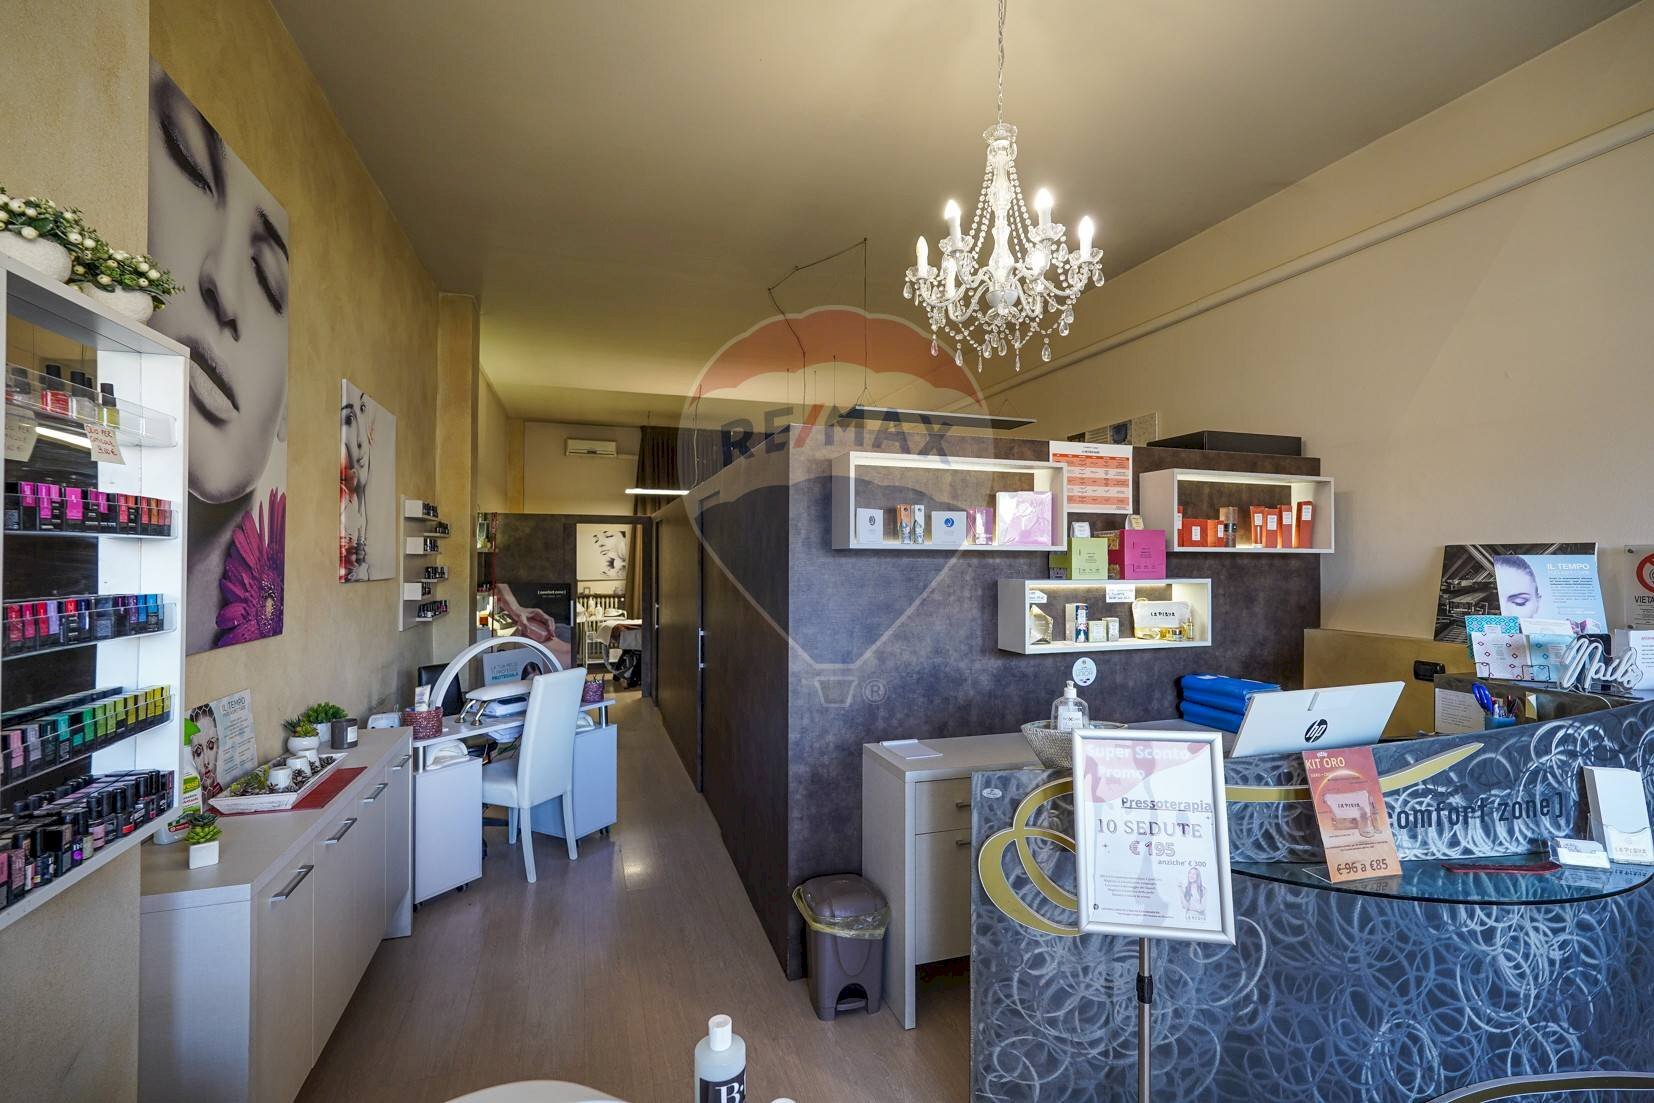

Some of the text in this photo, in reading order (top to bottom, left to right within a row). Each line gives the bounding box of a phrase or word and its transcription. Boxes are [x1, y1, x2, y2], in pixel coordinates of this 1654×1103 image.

[1547, 563, 1590, 571] IL TEMPO
[1562, 637, 1643, 689] Nails
[228, 696, 246, 710] TEMPO
[1305, 719, 1327, 743] hp
[1135, 745, 1190, 761] Sconto
[1305, 757, 1346, 769] KIT ORO
[1120, 796, 1212, 813] Pressoterapia
[1498, 791, 1563, 822] zone]
[1098, 818, 1203, 839] 10 SEDUTE
[1129, 840, 1176, 857] € 195
[1360, 862, 1367, 873] a
[1369, 858, 1389, 872] €85
